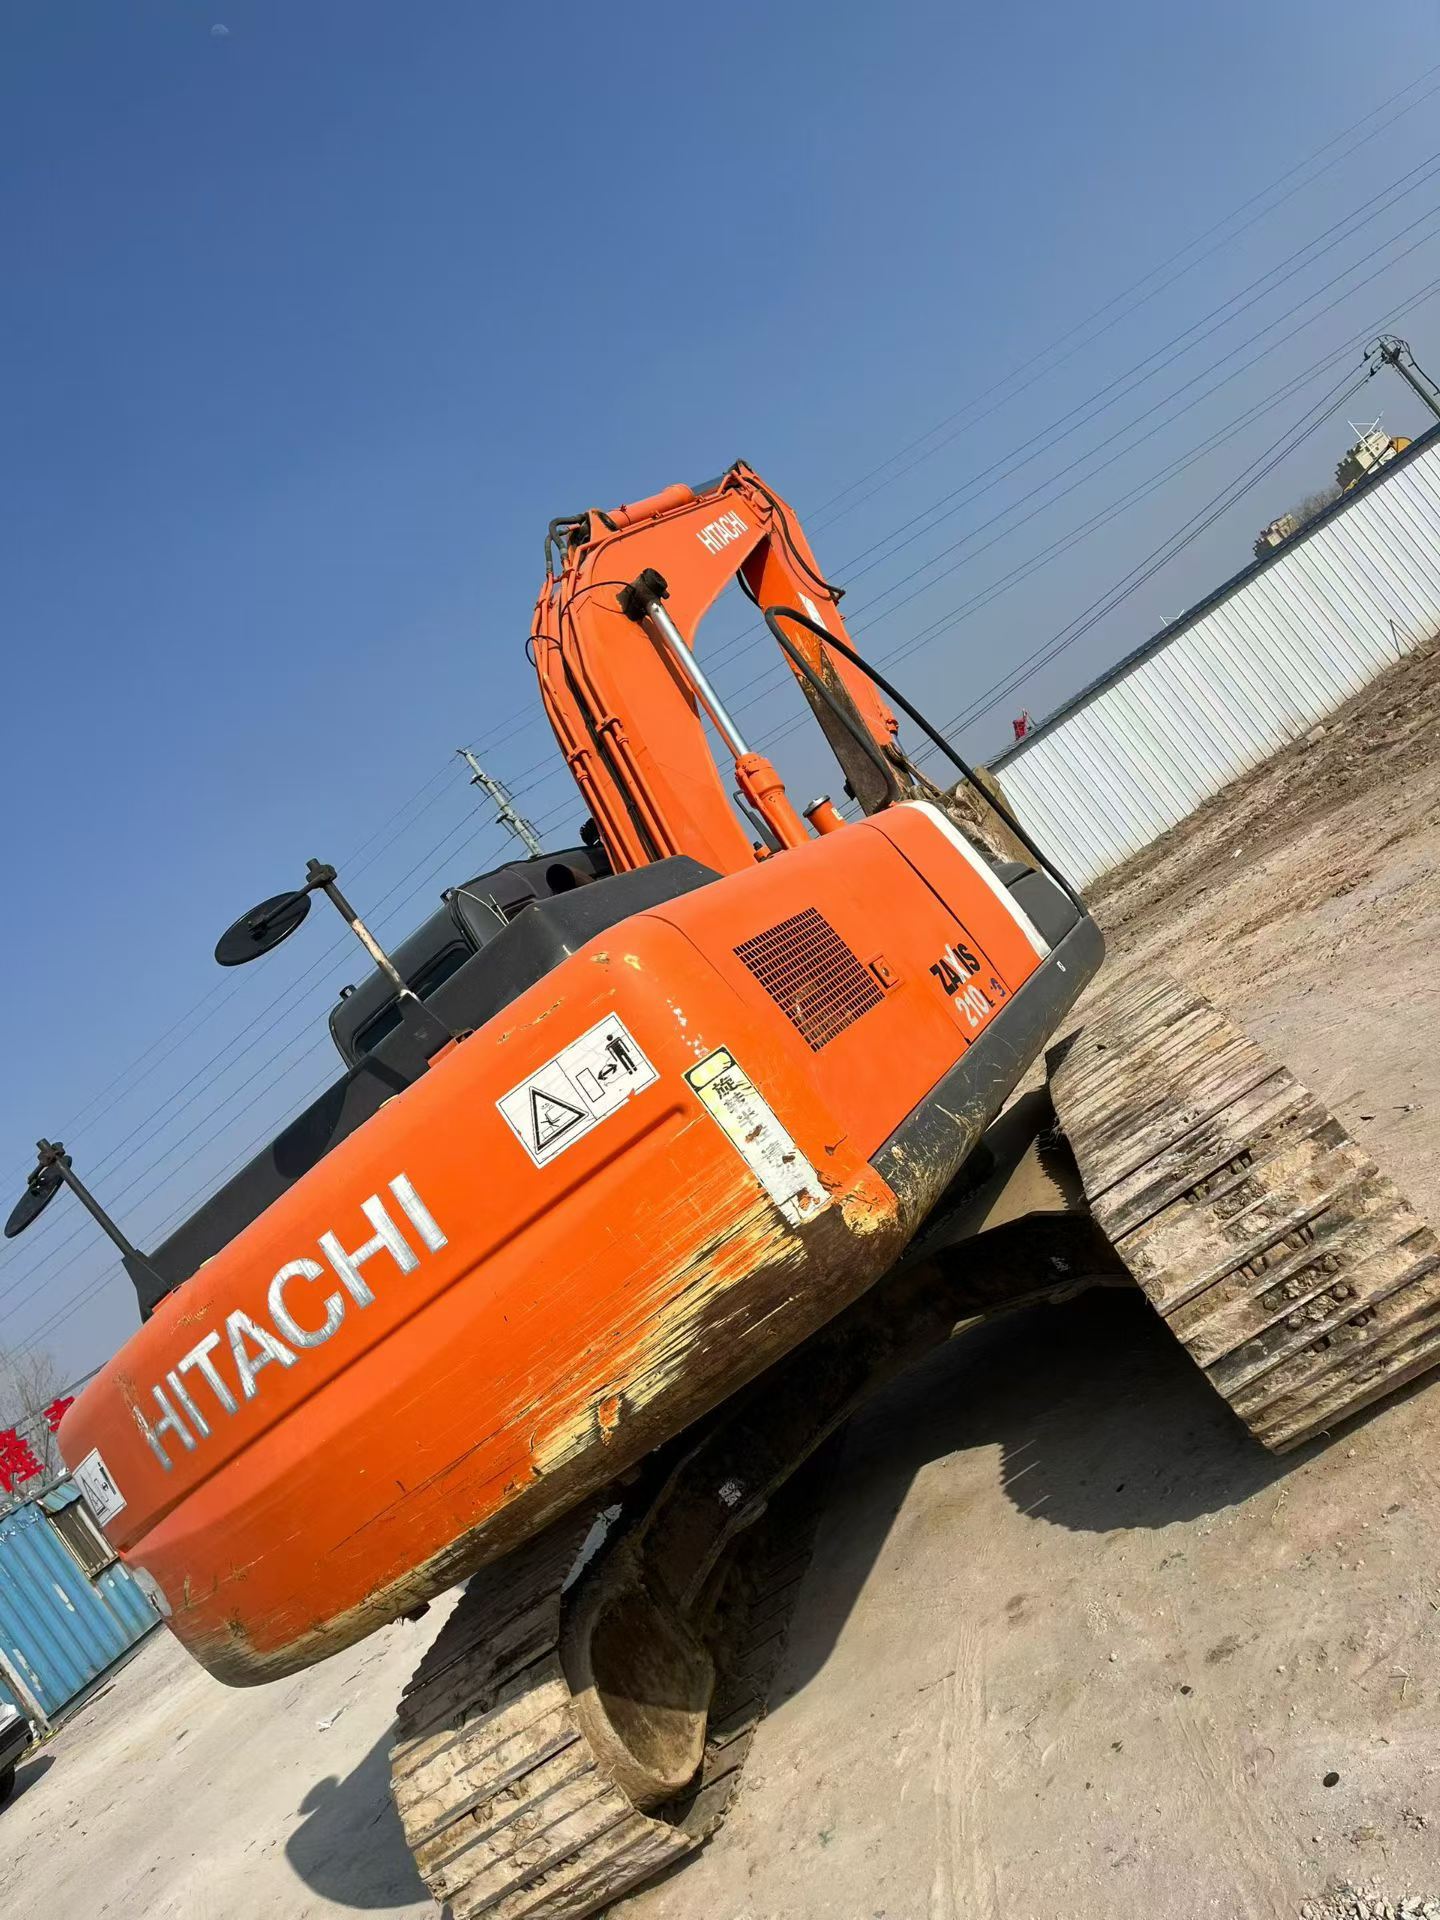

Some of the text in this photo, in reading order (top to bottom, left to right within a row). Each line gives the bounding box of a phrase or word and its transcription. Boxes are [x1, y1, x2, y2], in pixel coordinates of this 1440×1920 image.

[696, 510, 749, 555] HITACHI
[929, 943, 981, 996] ZAXIS
[132, 1172, 449, 1473] HITACHI
